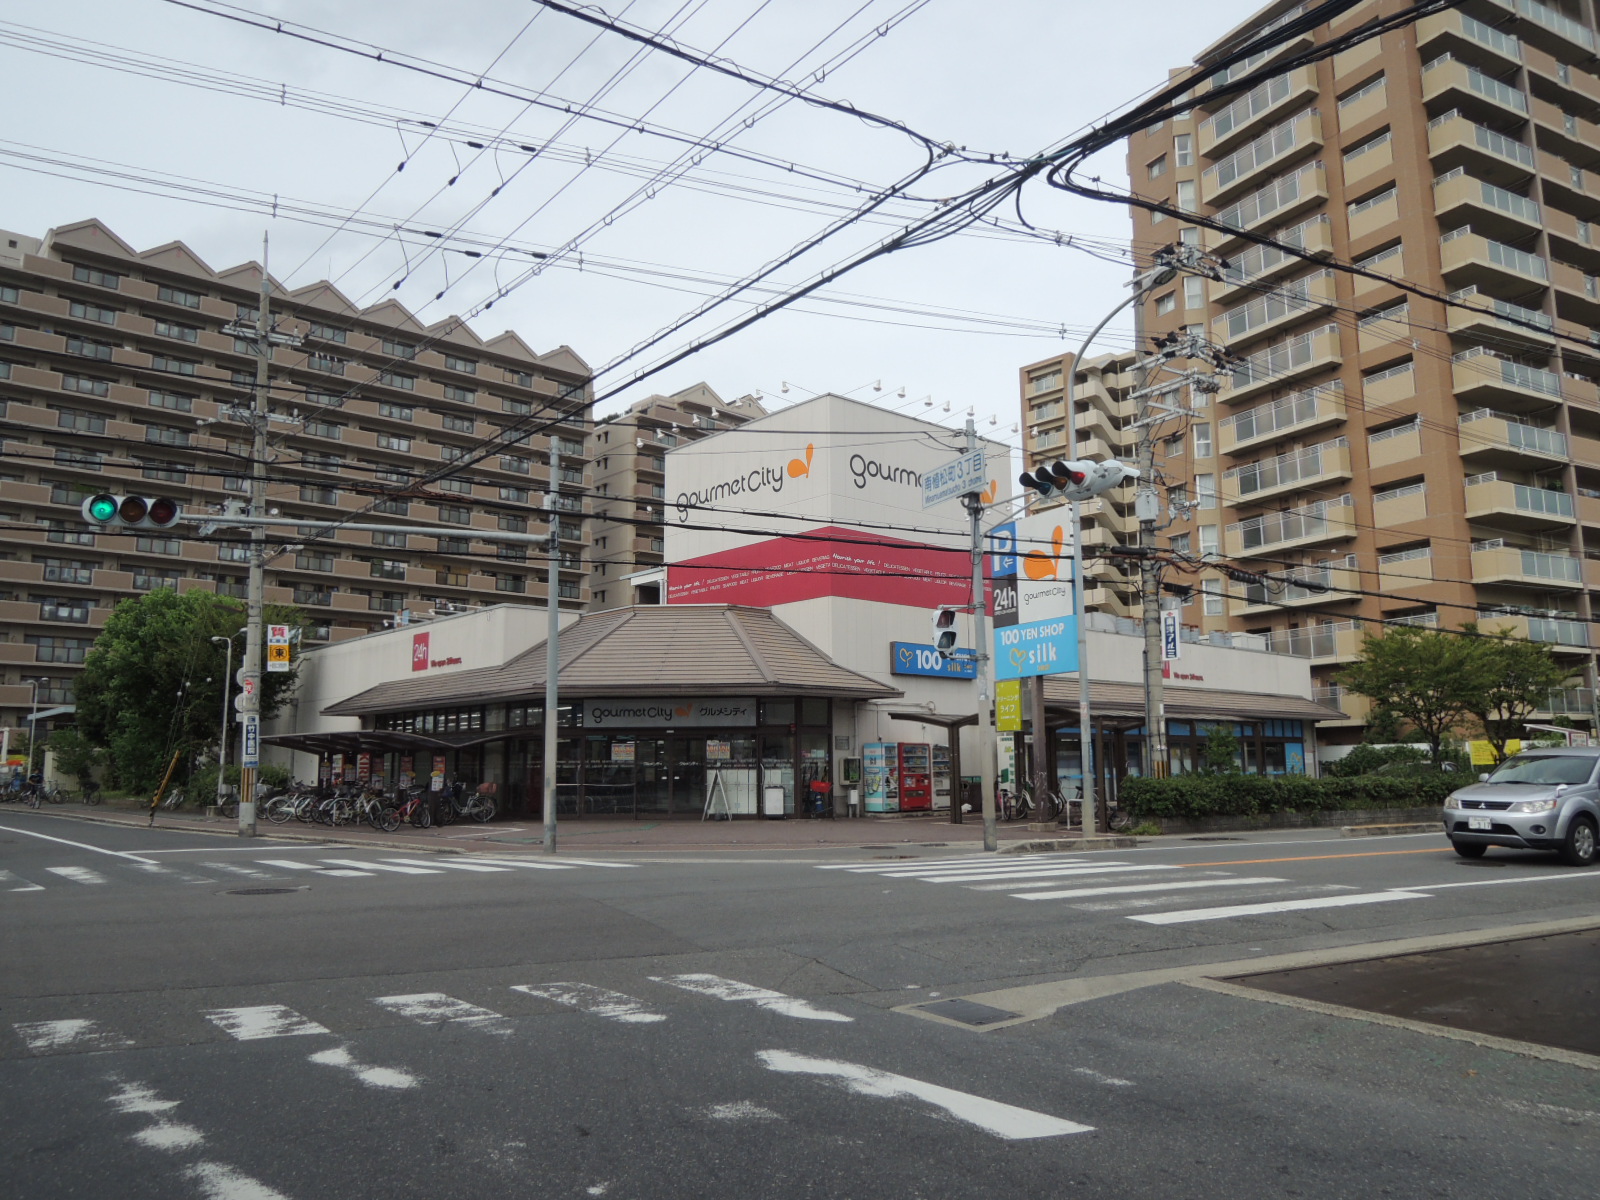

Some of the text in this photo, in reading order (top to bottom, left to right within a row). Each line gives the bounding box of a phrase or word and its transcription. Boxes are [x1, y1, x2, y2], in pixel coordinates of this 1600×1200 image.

[994, 586, 1017, 610] 24h
[1001, 622, 1065, 646] 100 YEN SHOP
[413, 642, 428, 662] 24h
[915, 649, 943, 671] 100
[1029, 642, 1057, 664] silk
[700, 706, 748, 717] グルメシティ
[1000, 704, 1016, 713] ライフ
